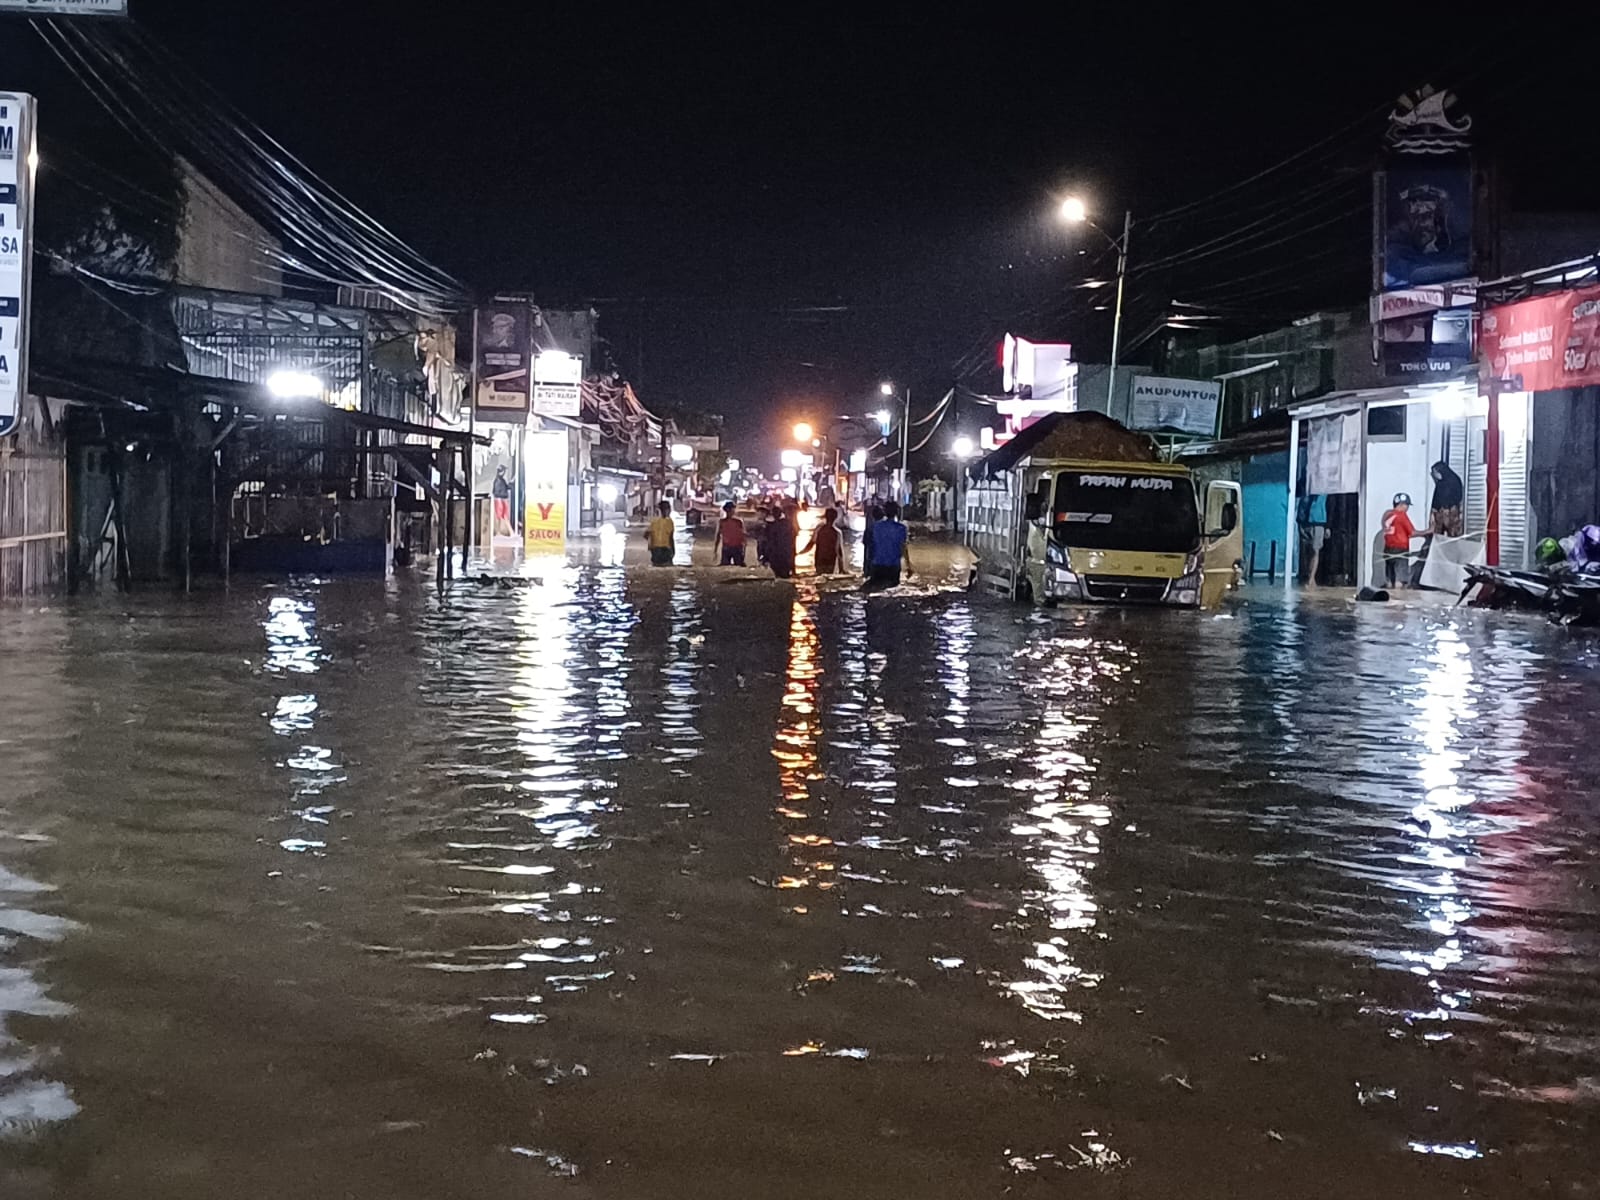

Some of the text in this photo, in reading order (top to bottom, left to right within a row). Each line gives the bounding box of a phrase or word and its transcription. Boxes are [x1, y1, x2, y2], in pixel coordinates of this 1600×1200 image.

[1400, 363, 1427, 371] TOKO
[1136, 387, 1217, 401] AKUPUNTUR
[1130, 477, 1173, 491] MUDA
[528, 529, 561, 539] SALON
